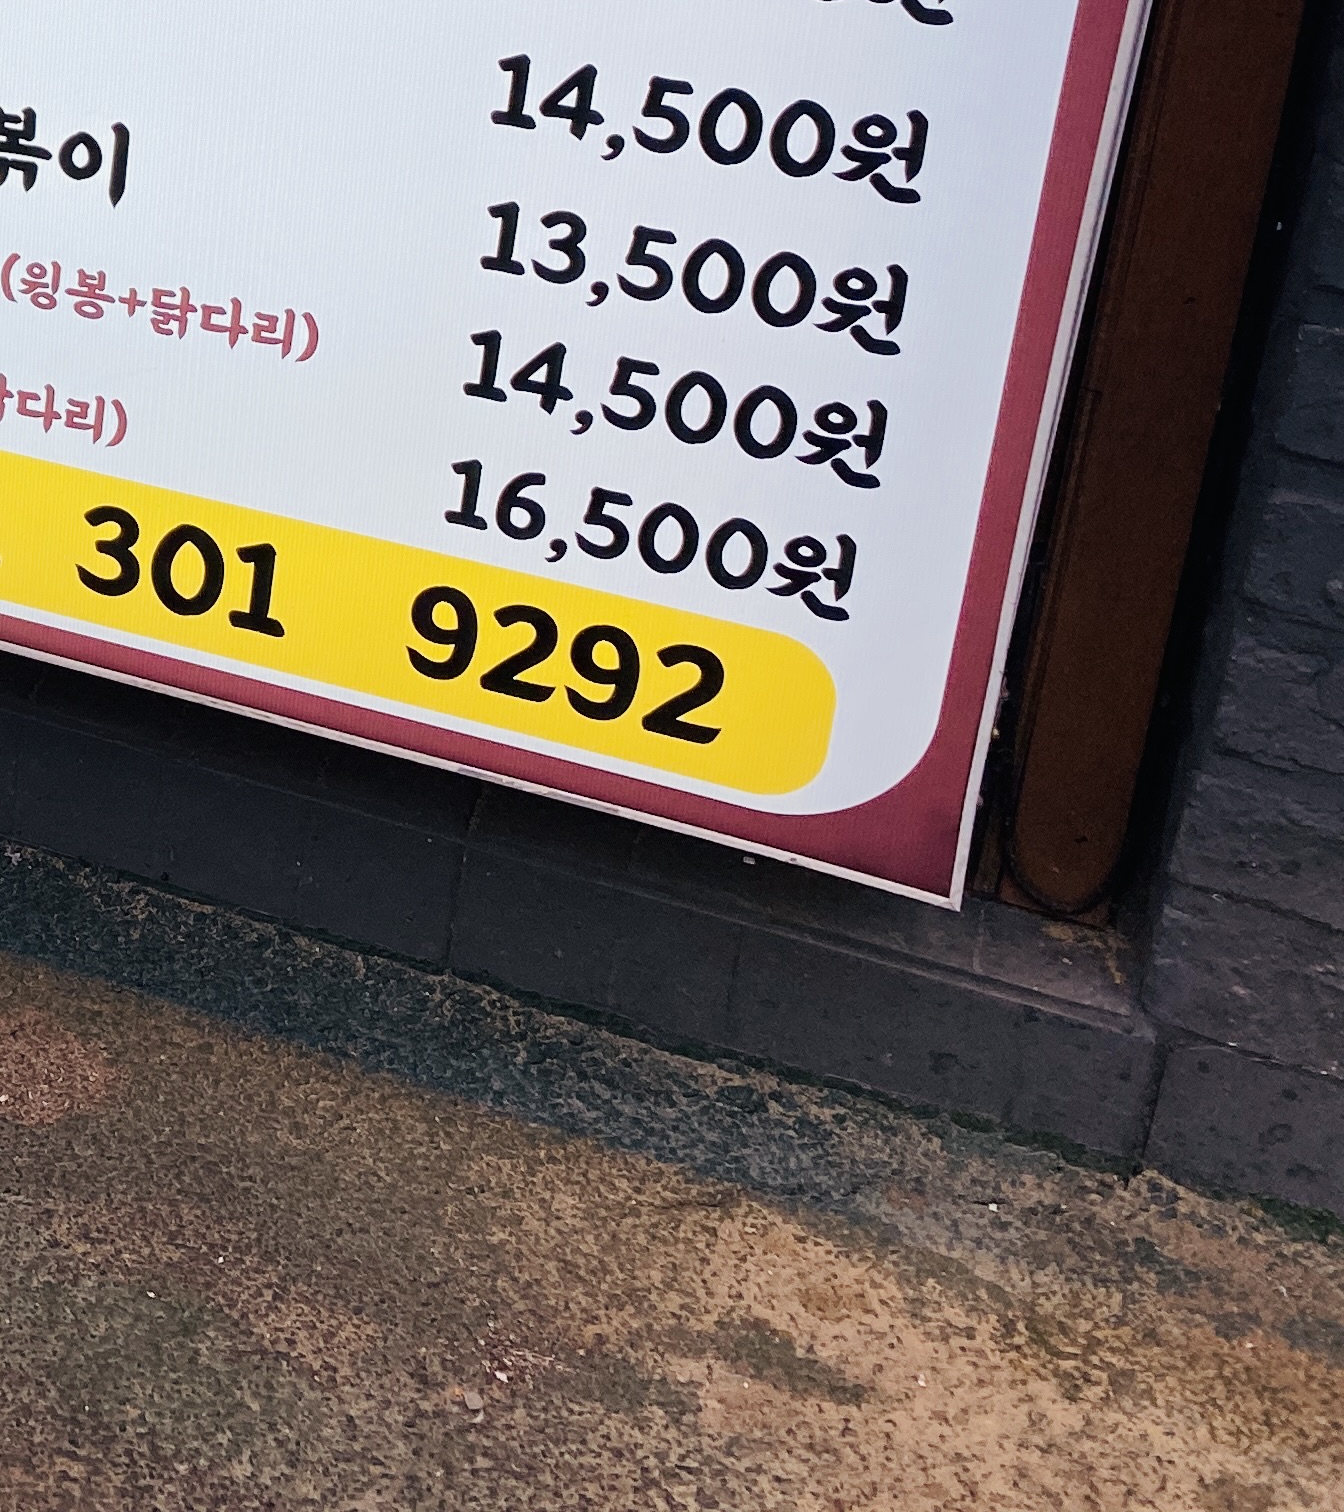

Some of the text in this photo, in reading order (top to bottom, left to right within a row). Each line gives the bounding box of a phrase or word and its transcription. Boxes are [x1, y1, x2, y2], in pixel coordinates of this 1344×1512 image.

[490, 53, 930, 204] 14,500원
[479, 200, 909, 357] 13,500원
[462, 328, 889, 490] 14,500원
[443, 458, 859, 623] 16,500원
[75, 505, 286, 640] 301
[405, 583, 727, 747] 9292
